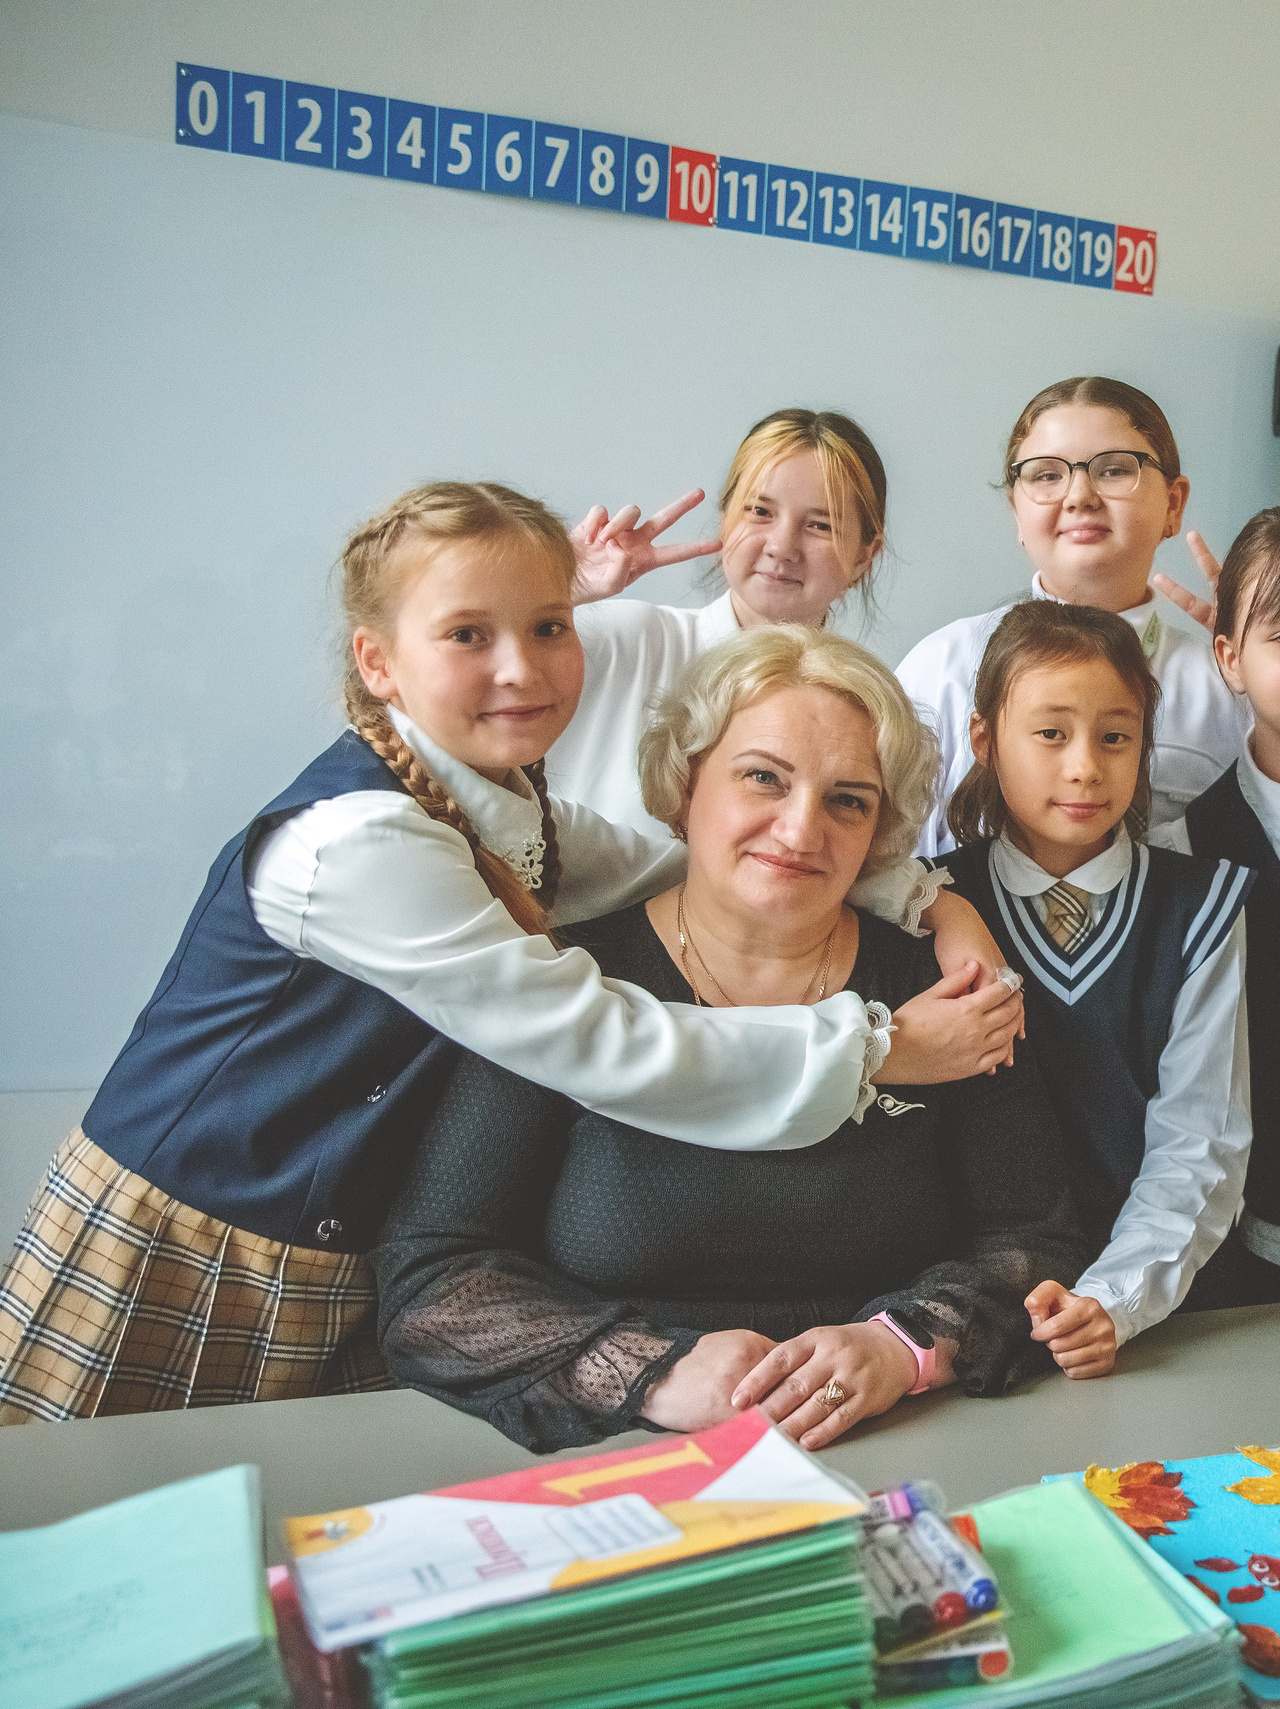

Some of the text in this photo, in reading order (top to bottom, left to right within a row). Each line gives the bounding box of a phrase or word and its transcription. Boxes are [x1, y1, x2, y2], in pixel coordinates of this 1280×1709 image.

[188, 81, 1154, 285] 0 1 2 3 4 5 6 7 8 9 10 11 12 13 14 15 16 17 18 19 20
[541, 1440, 714, 1499] 1
